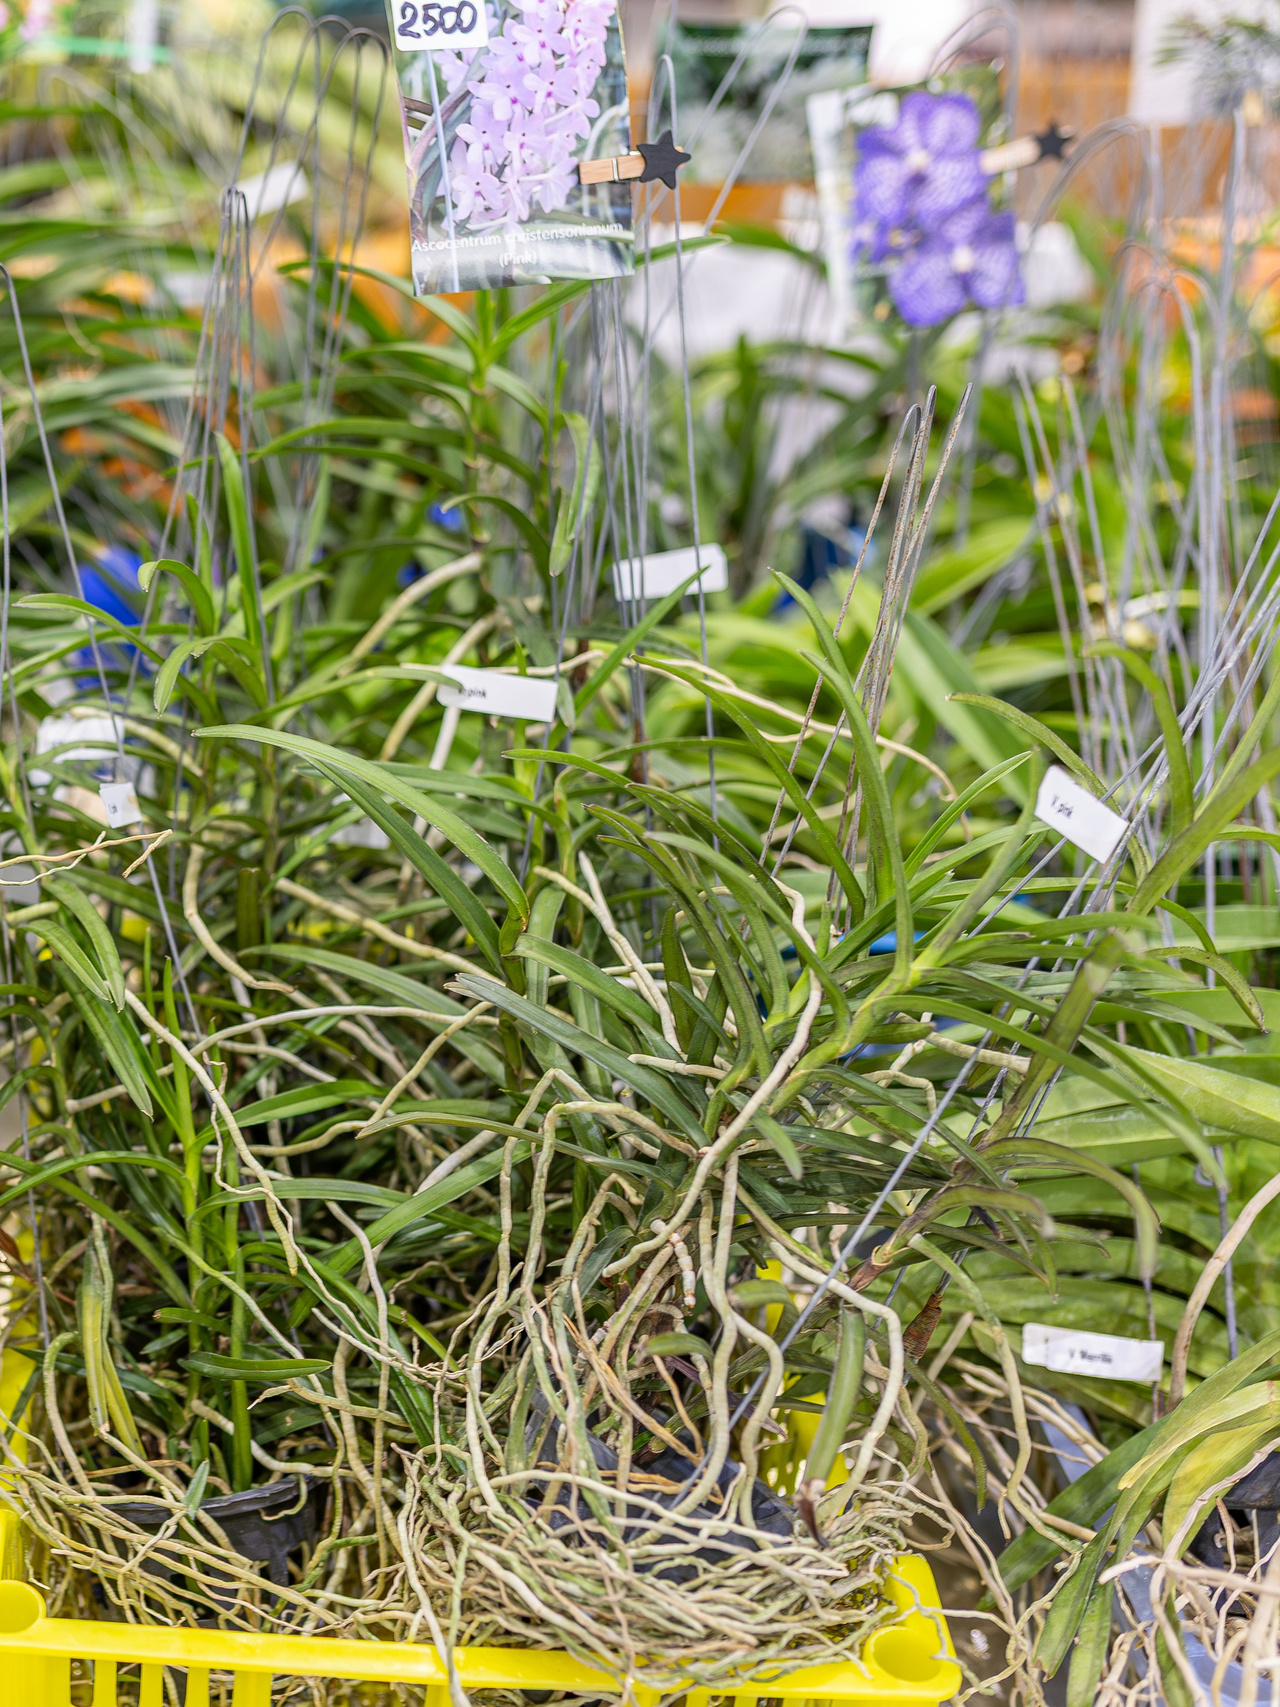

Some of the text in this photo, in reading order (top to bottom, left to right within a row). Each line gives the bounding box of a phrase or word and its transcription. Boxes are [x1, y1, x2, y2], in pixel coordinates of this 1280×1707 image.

[398, 0, 478, 39] 2500
[411, 234, 502, 252] Ascocentrum
[498, 250, 538, 268] (Pink)
